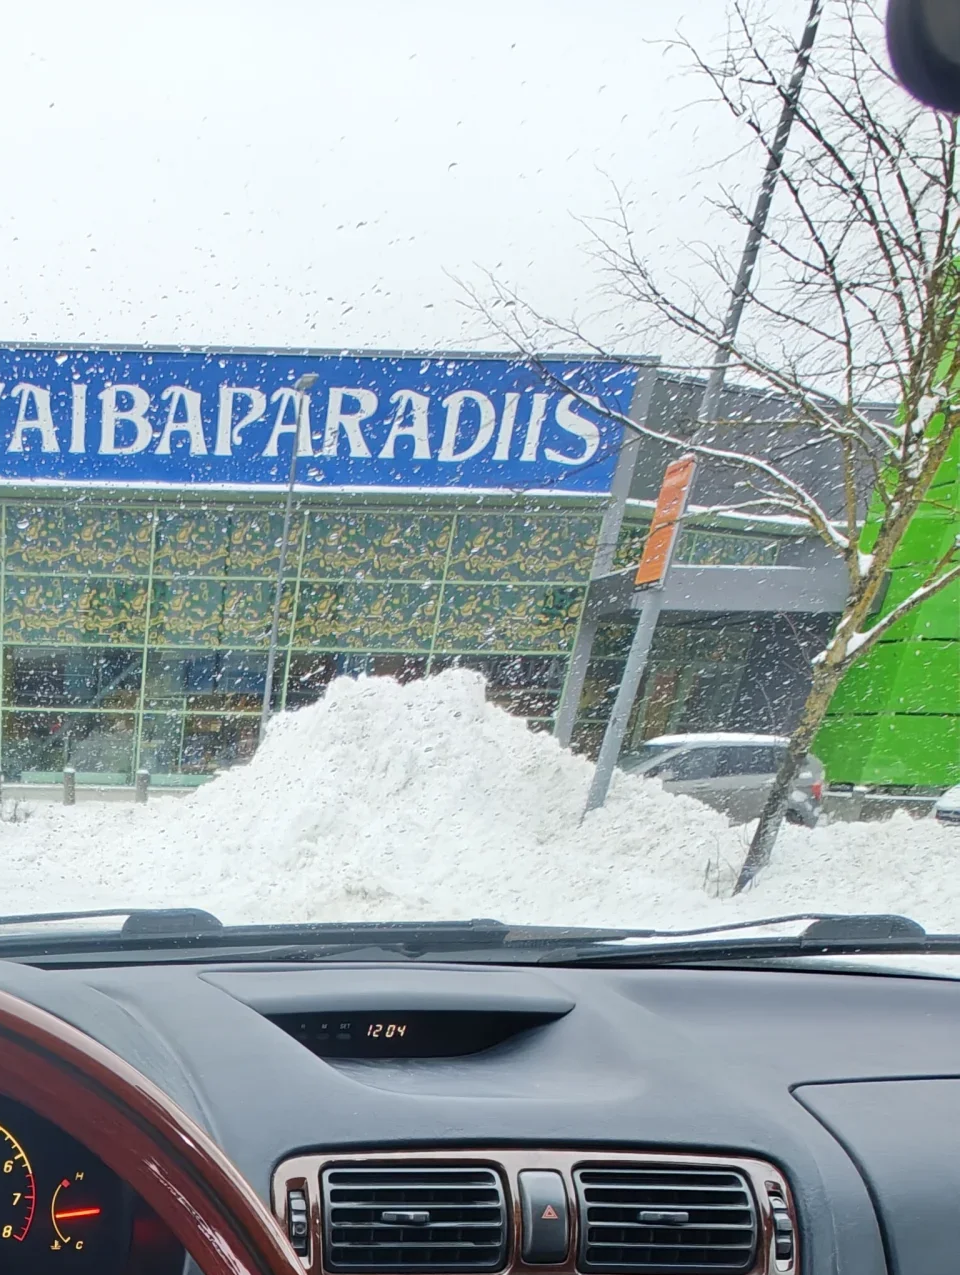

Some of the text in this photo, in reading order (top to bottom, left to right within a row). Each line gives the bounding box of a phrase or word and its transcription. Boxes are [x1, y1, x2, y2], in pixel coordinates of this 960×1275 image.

[3, 1161, 14, 1173] 6
[75, 1172, 84, 1181] H
[12, 1193, 22, 1206] 7
[2, 1225, 12, 1238] 8
[75, 1241, 84, 1250] C
